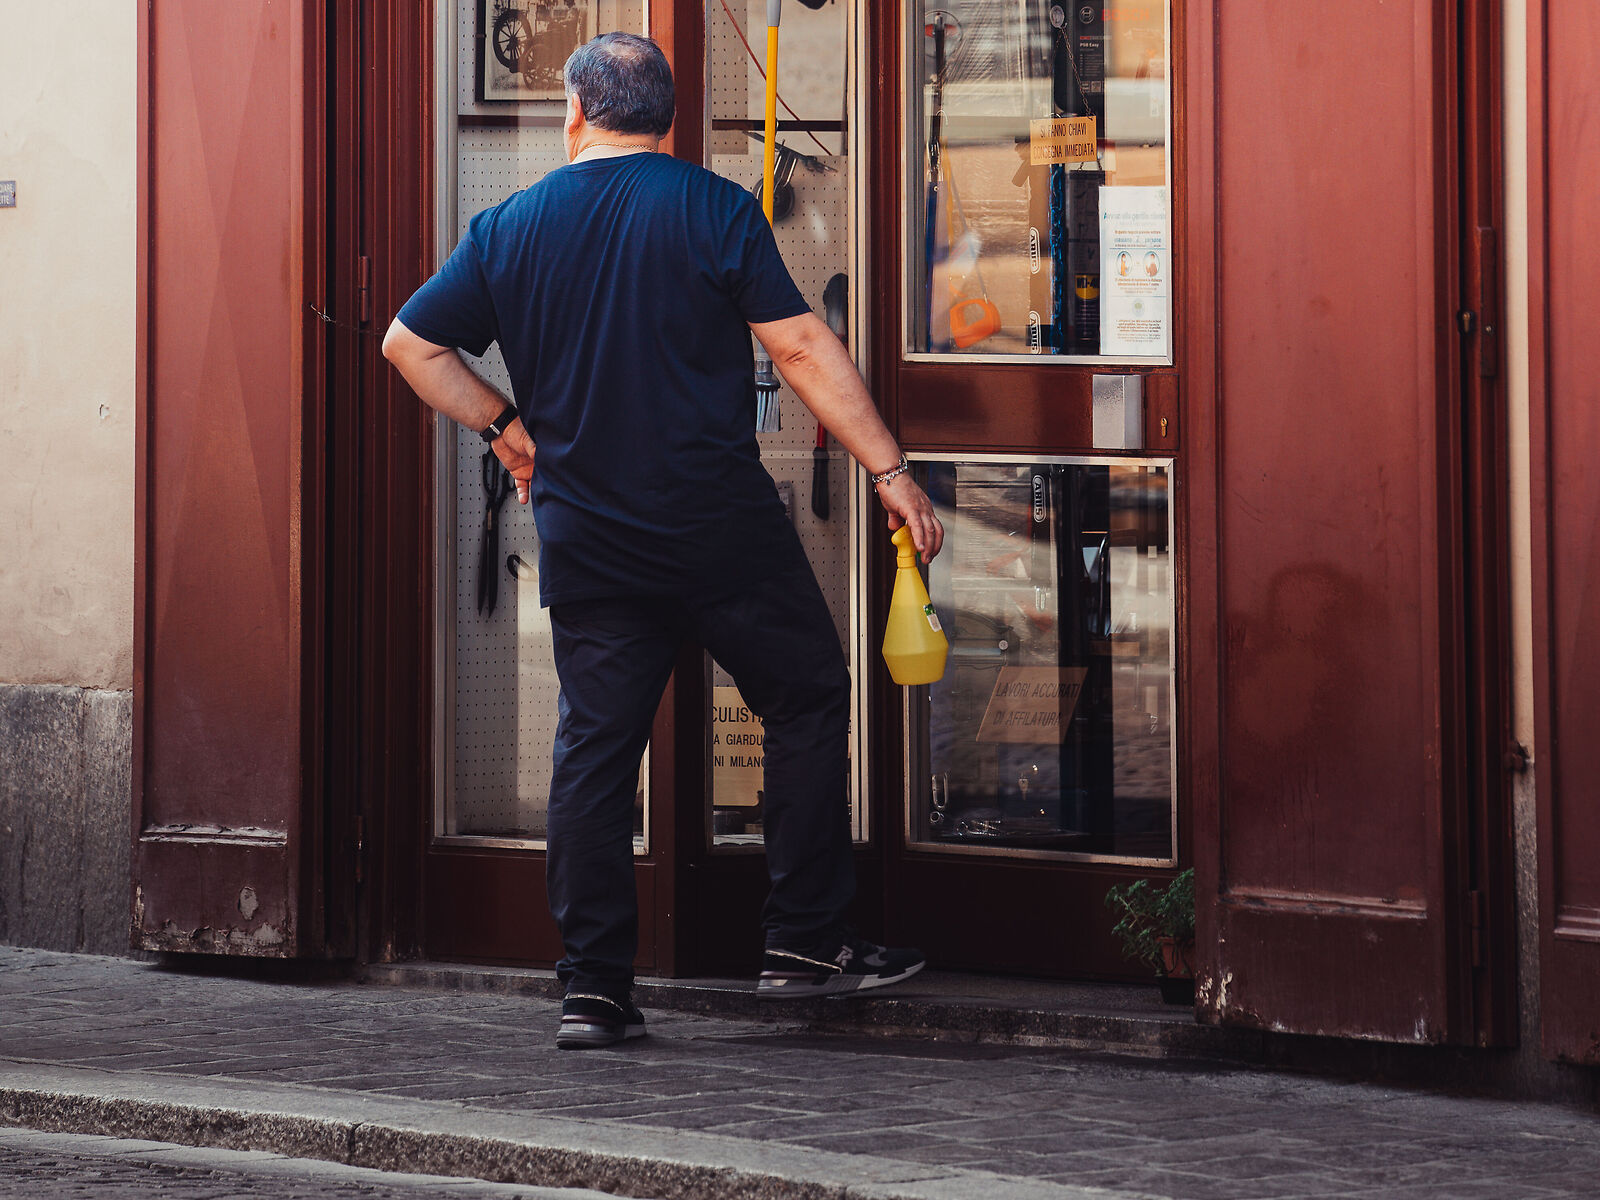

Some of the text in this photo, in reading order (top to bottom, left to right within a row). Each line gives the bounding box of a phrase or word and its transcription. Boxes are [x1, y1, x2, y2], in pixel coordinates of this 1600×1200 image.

[1068, 122, 1087, 136] CHIAVI
[1033, 142, 1095, 160] CONSEGNA IMMEDIATA
[1034, 482, 1043, 516] ABUS
[996, 682, 1080, 698] LAVORI ACCURATI
[993, 710, 1064, 727] DI AFFILATURA
